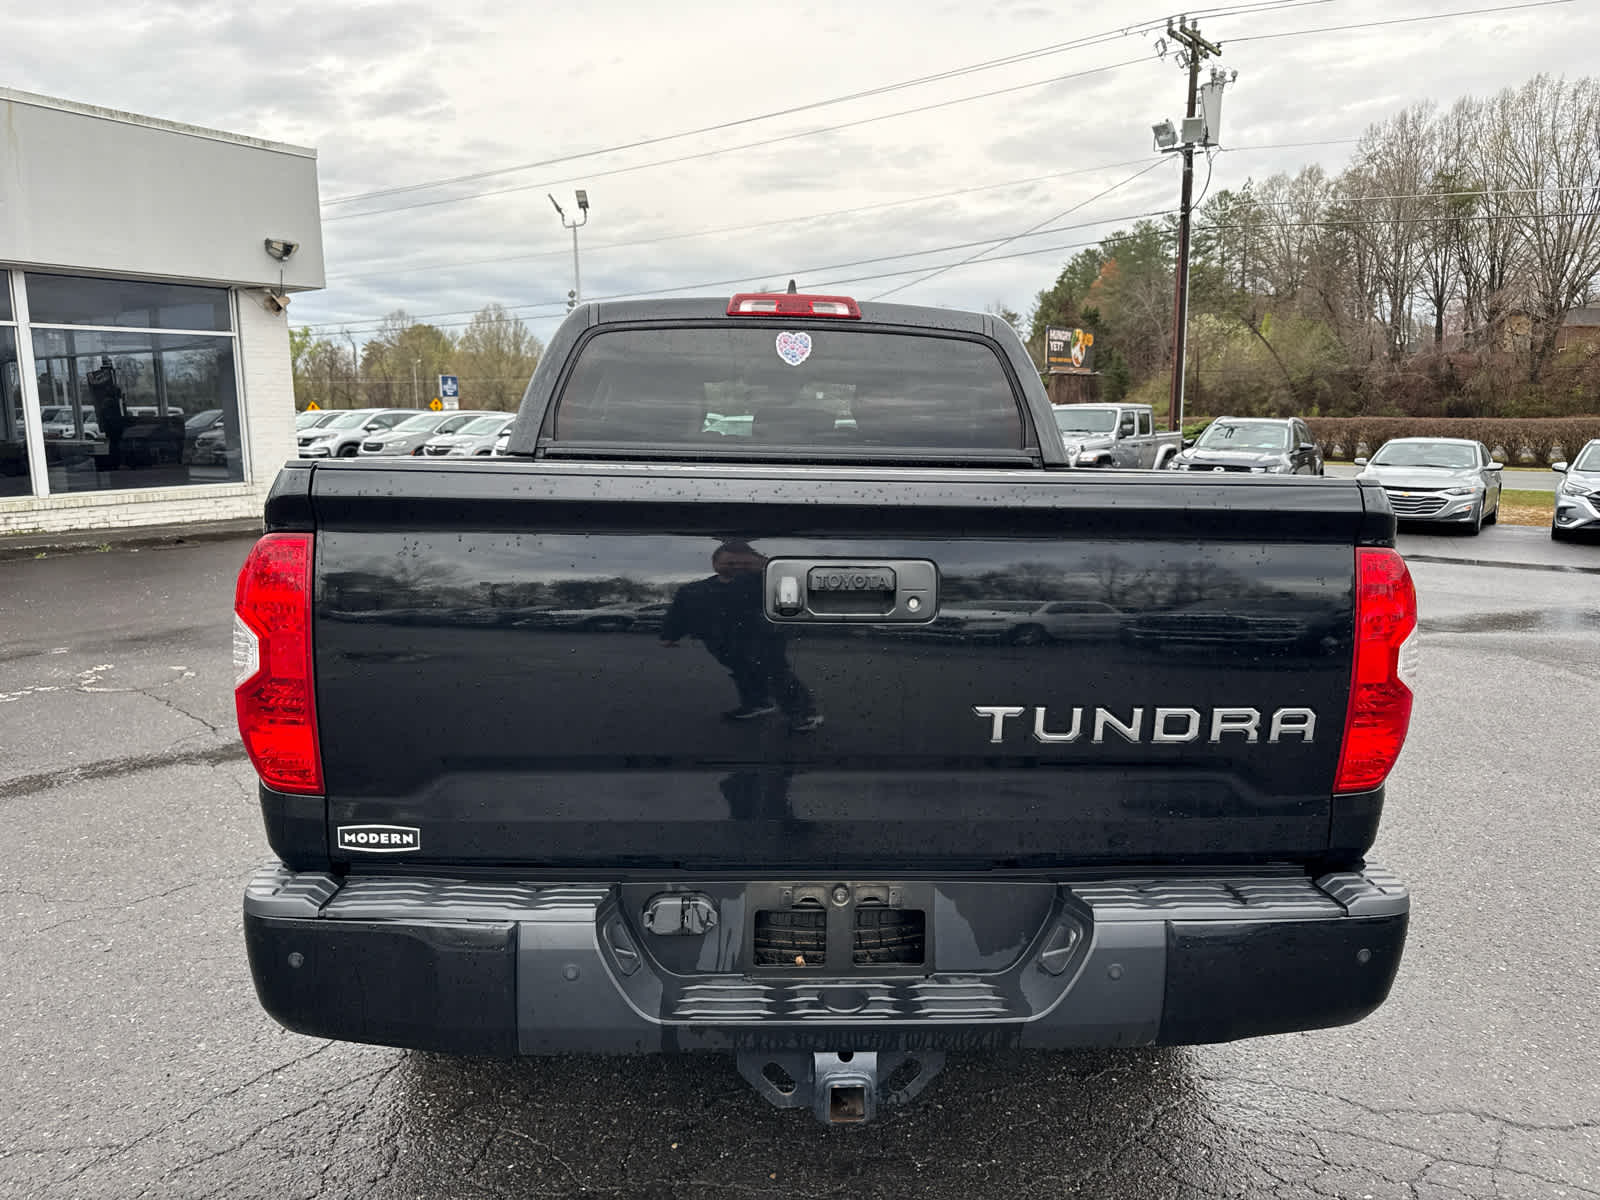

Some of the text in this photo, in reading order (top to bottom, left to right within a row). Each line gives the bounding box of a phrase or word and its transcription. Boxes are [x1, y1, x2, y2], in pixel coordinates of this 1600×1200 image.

[815, 573, 890, 588] TOYOTA
[972, 706, 1317, 743] TUNDRA
[344, 832, 414, 844] MODERN
